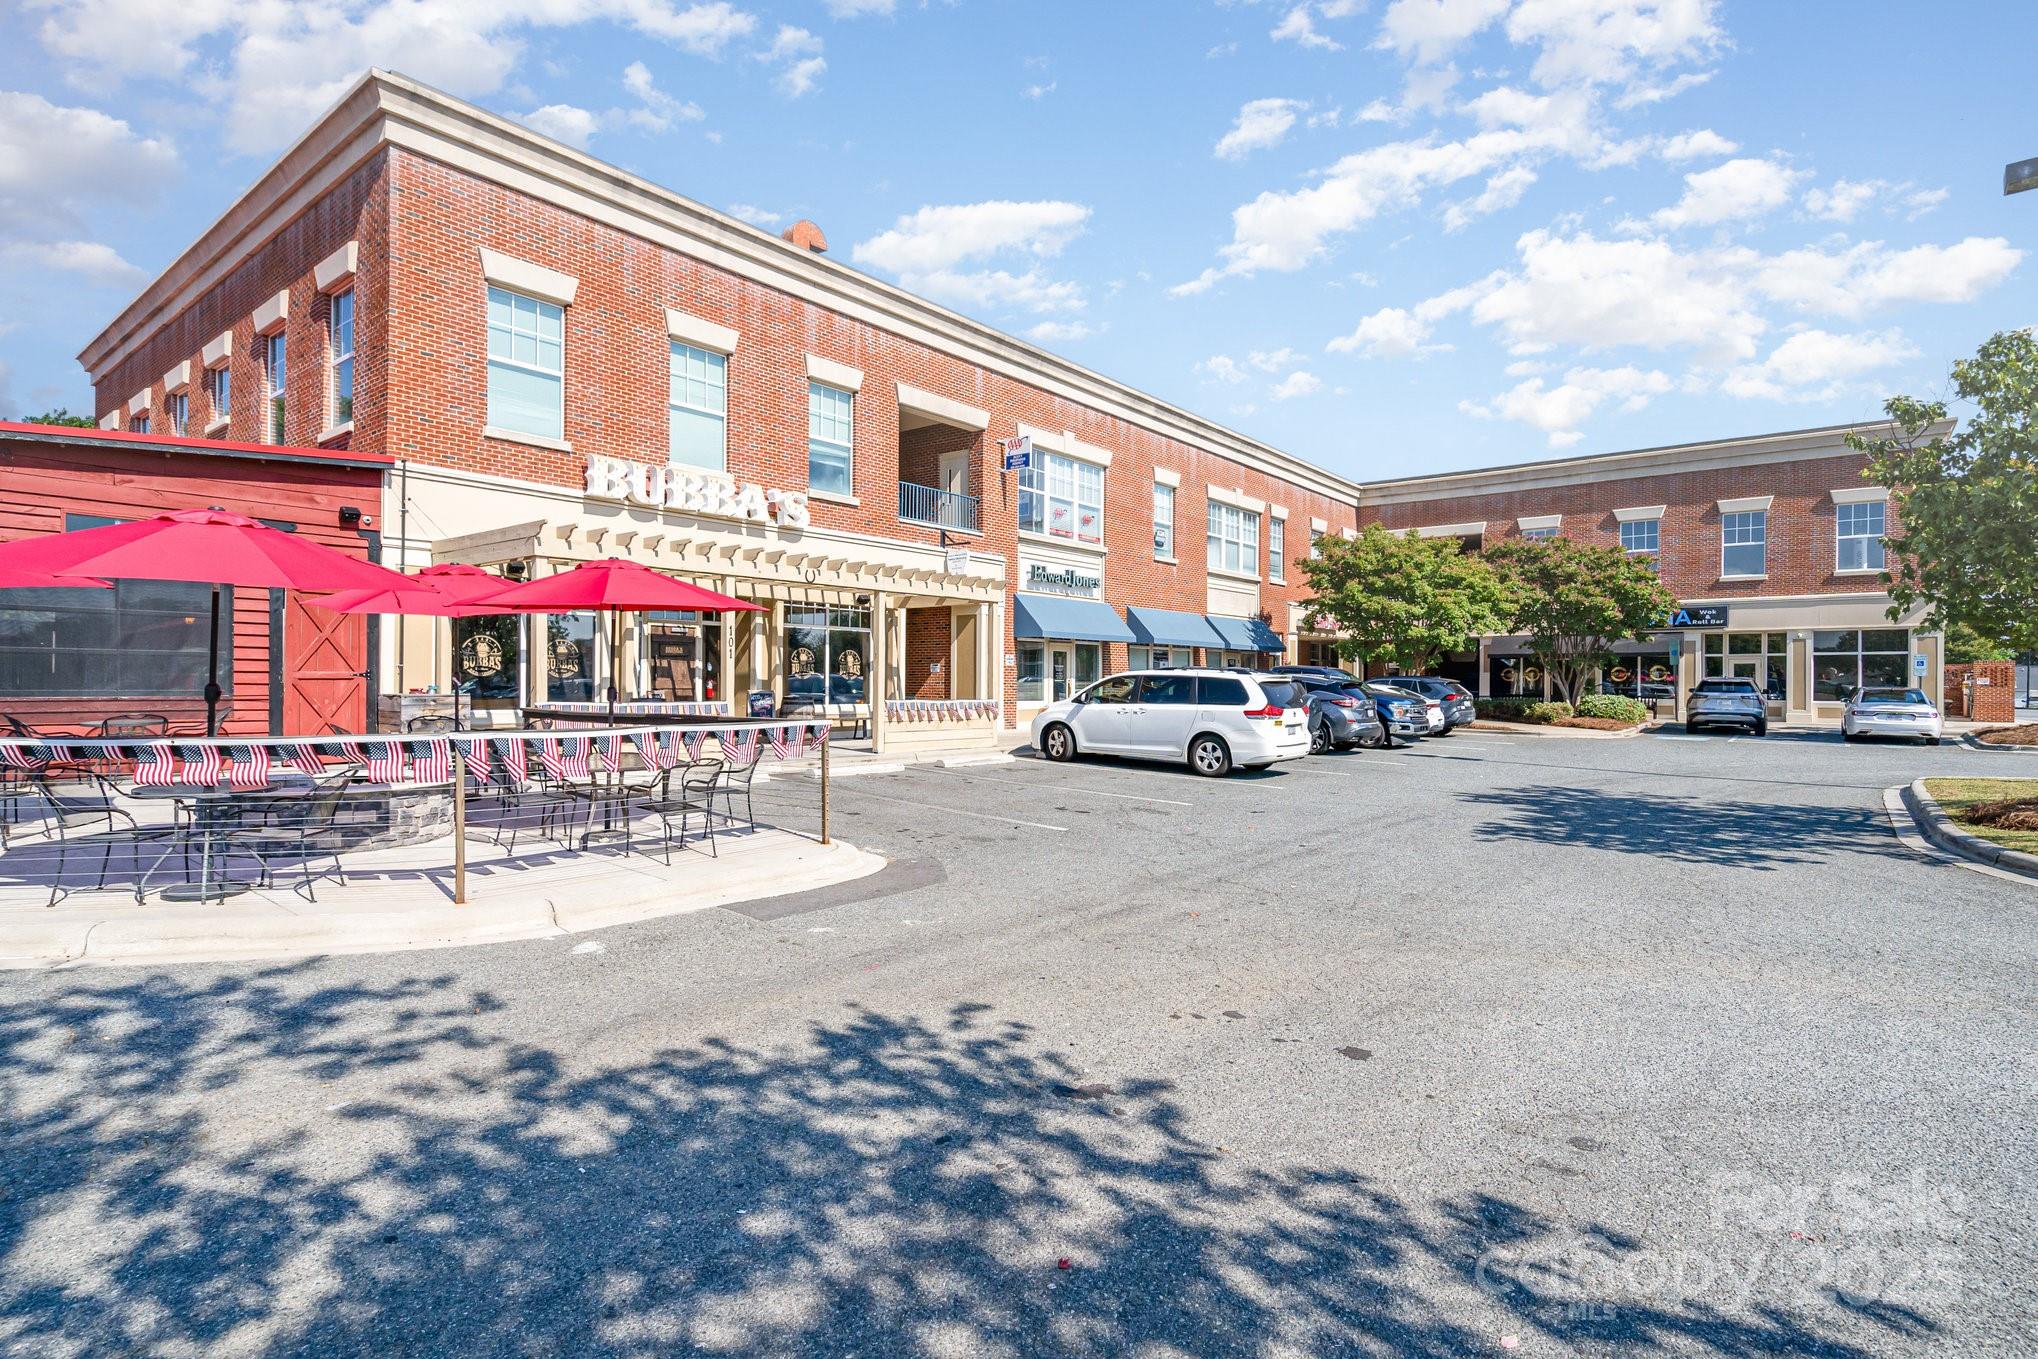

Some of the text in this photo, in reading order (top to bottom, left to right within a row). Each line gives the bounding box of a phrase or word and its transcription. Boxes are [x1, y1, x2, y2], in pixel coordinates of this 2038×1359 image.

[583, 453, 810, 527] BUBBA'S
[1027, 564, 1100, 588] Edward Jones
